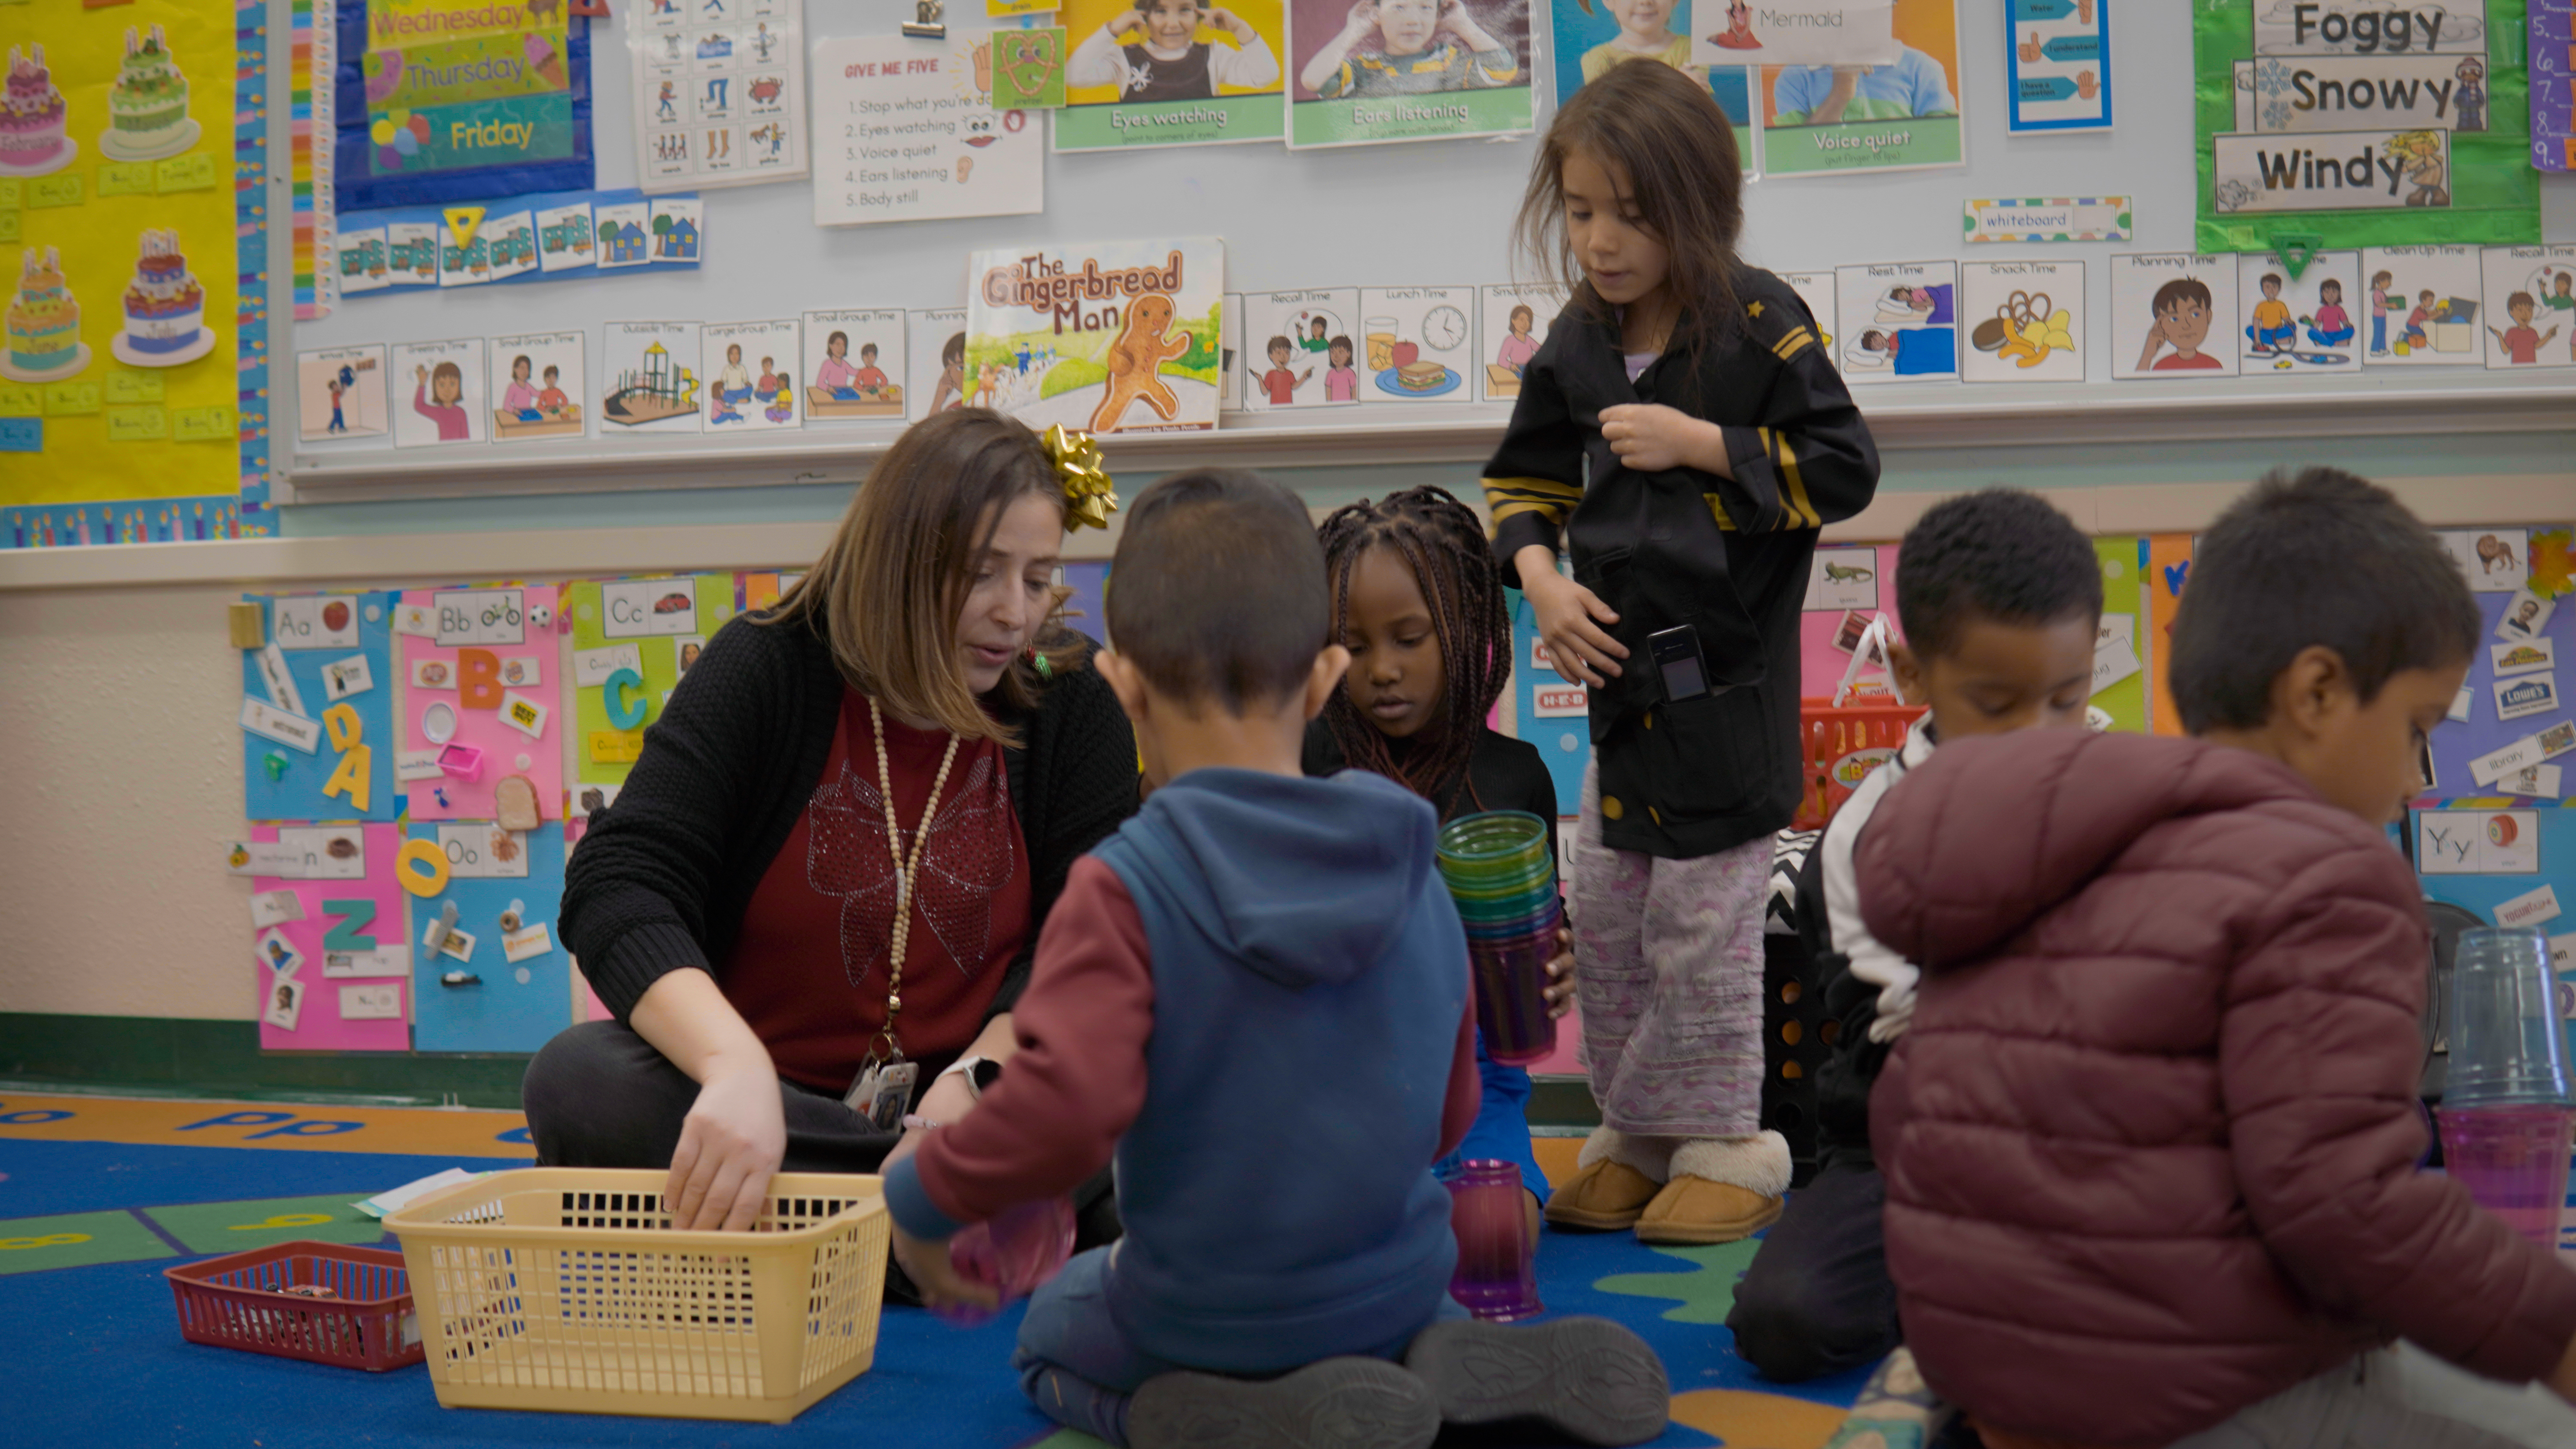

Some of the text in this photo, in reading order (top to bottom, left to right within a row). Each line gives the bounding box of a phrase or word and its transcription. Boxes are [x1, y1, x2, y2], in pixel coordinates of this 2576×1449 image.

[1761, 9, 1843, 28] Mermaid
[2030, 4, 2054, 13] Water
[372, 3, 526, 36] Wednesday
[2293, 3, 2443, 54] Foggy
[2054, 42, 2098, 52] understand
[406, 55, 525, 89] Thursday
[844, 58, 939, 79] GIVE ME FIVE
[2021, 89, 2055, 99] question
[2025, 81, 2044, 89] have
[2291, 70, 2452, 119] Snowy
[860, 100, 891, 115] Stop
[895, 95, 928, 111] what
[932, 94, 972, 112] you're
[1013, 96, 1043, 107] pretzel
[1112, 106, 1227, 132] Eyes watching
[1353, 103, 1469, 124] Ears listening
[451, 118, 533, 150] Friday
[845, 120, 956, 140] 2. Eyes watching
[846, 144, 937, 160] 3. Voice quiet
[1814, 130, 1911, 154] Voice quiet
[845, 167, 948, 183] 4. Ears listening
[2257, 146, 2404, 197] Windy
[846, 190, 918, 207] 5. Body still
[1987, 212, 2067, 227] whiteboard
[2132, 254, 2217, 268] Planning Time
[2382, 244, 2465, 258] Clean Up Time
[2511, 246, 2575, 258] Recall Time
[1021, 252, 1064, 279] The
[1868, 264, 1924, 277] Rest Time
[1990, 263, 2057, 275] Snack Time
[984, 251, 1182, 313] Gingerbread
[1786, 273, 1811, 285] Time
[1271, 291, 1331, 304] Recall Time
[1386, 288, 1447, 300] Lunch Time
[812, 311, 896, 324] Small Group Time
[1053, 300, 1120, 336] Man
[662, 323, 684, 334] Time
[708, 322, 792, 338] Large Group Time
[448, 342, 468, 350] Time
[524, 335, 552, 348] Group
[555, 333, 575, 343] Time
[441, 606, 471, 633] Bb
[612, 598, 643, 623] Cc
[278, 611, 311, 638] Aa
[458, 649, 504, 709] B
[603, 668, 647, 730] C
[2506, 685, 2545, 704] LOWE'S
[2488, 750, 2523, 771] library
[322, 743, 372, 812] A
[445, 839, 478, 865] Oo
[2426, 826, 2473, 864] Yy
[395, 838, 450, 898] O
